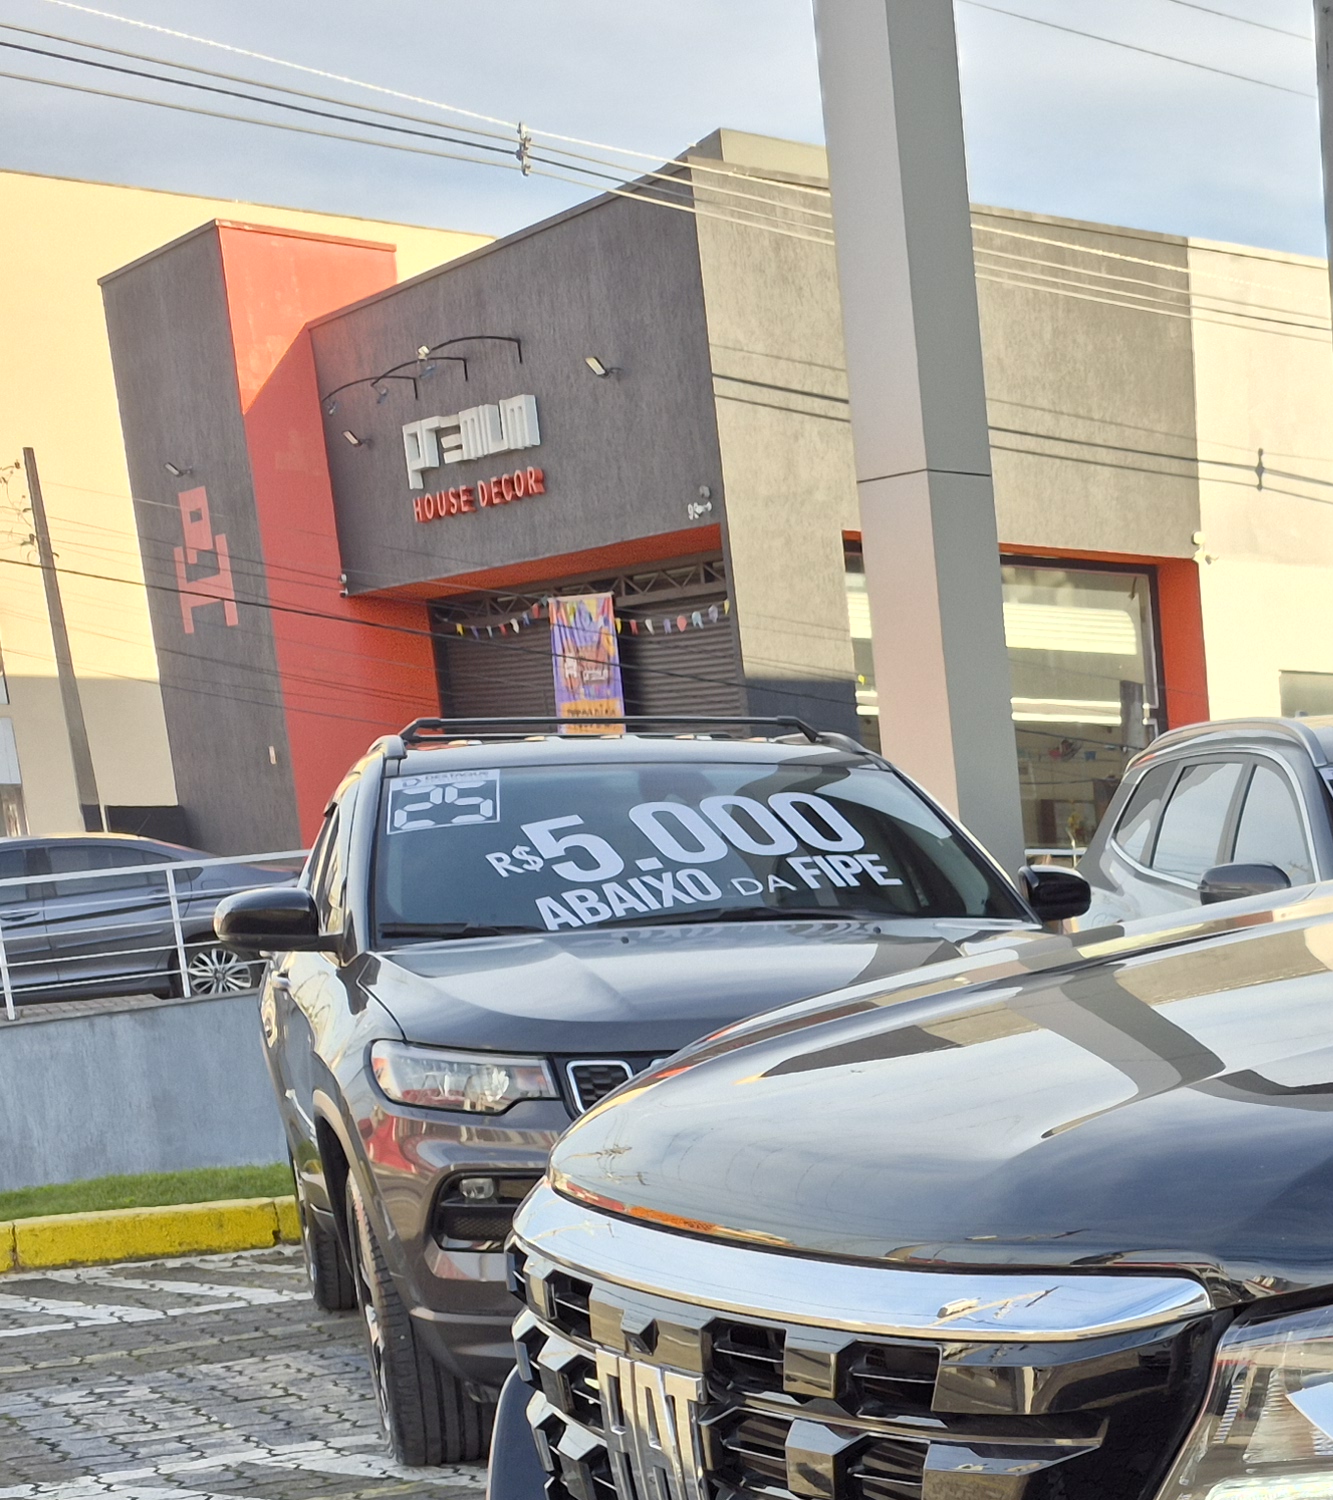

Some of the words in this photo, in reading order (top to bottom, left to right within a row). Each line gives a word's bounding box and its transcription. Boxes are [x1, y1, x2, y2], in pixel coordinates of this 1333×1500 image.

[413, 484, 475, 522] HOUSE
[477, 466, 545, 508] DECOR
[393, 781, 494, 830] 25
[534, 868, 723, 931] ABAIXO
[730, 876, 798, 897] DA
[786, 853, 904, 890] FIPE
